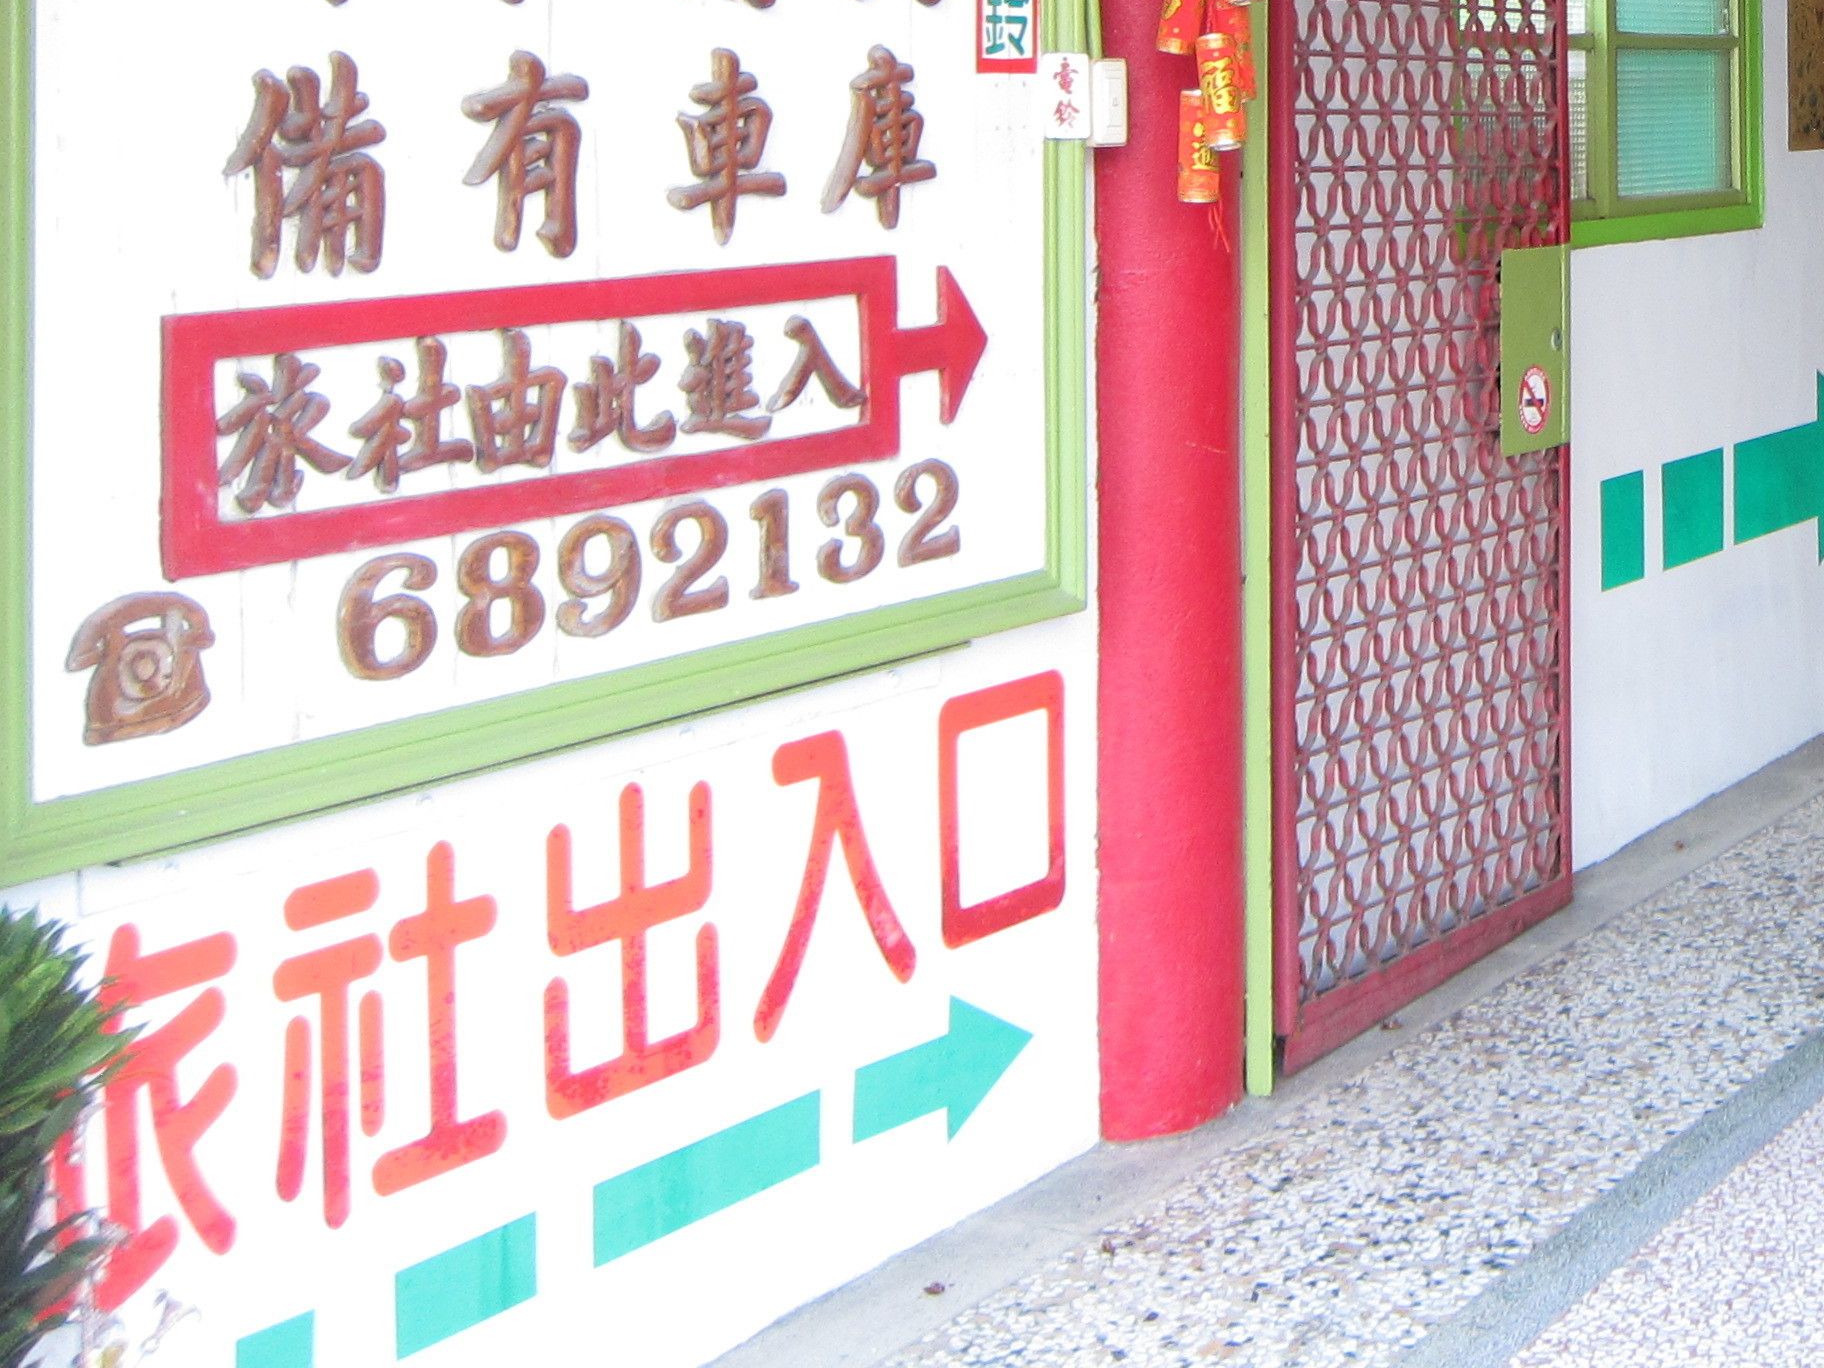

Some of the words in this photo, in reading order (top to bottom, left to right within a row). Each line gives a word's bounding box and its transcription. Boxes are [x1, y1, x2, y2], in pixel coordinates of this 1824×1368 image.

[223, 44, 939, 280] 備有車庫
[1052, 55, 1081, 129] 電鈴
[1200, 56, 1242, 115] 福
[216, 315, 869, 513] 旅社由此進入
[336, 458, 962, 682] 6892132
[36, 668, 1067, 1322] 旅社出入口
